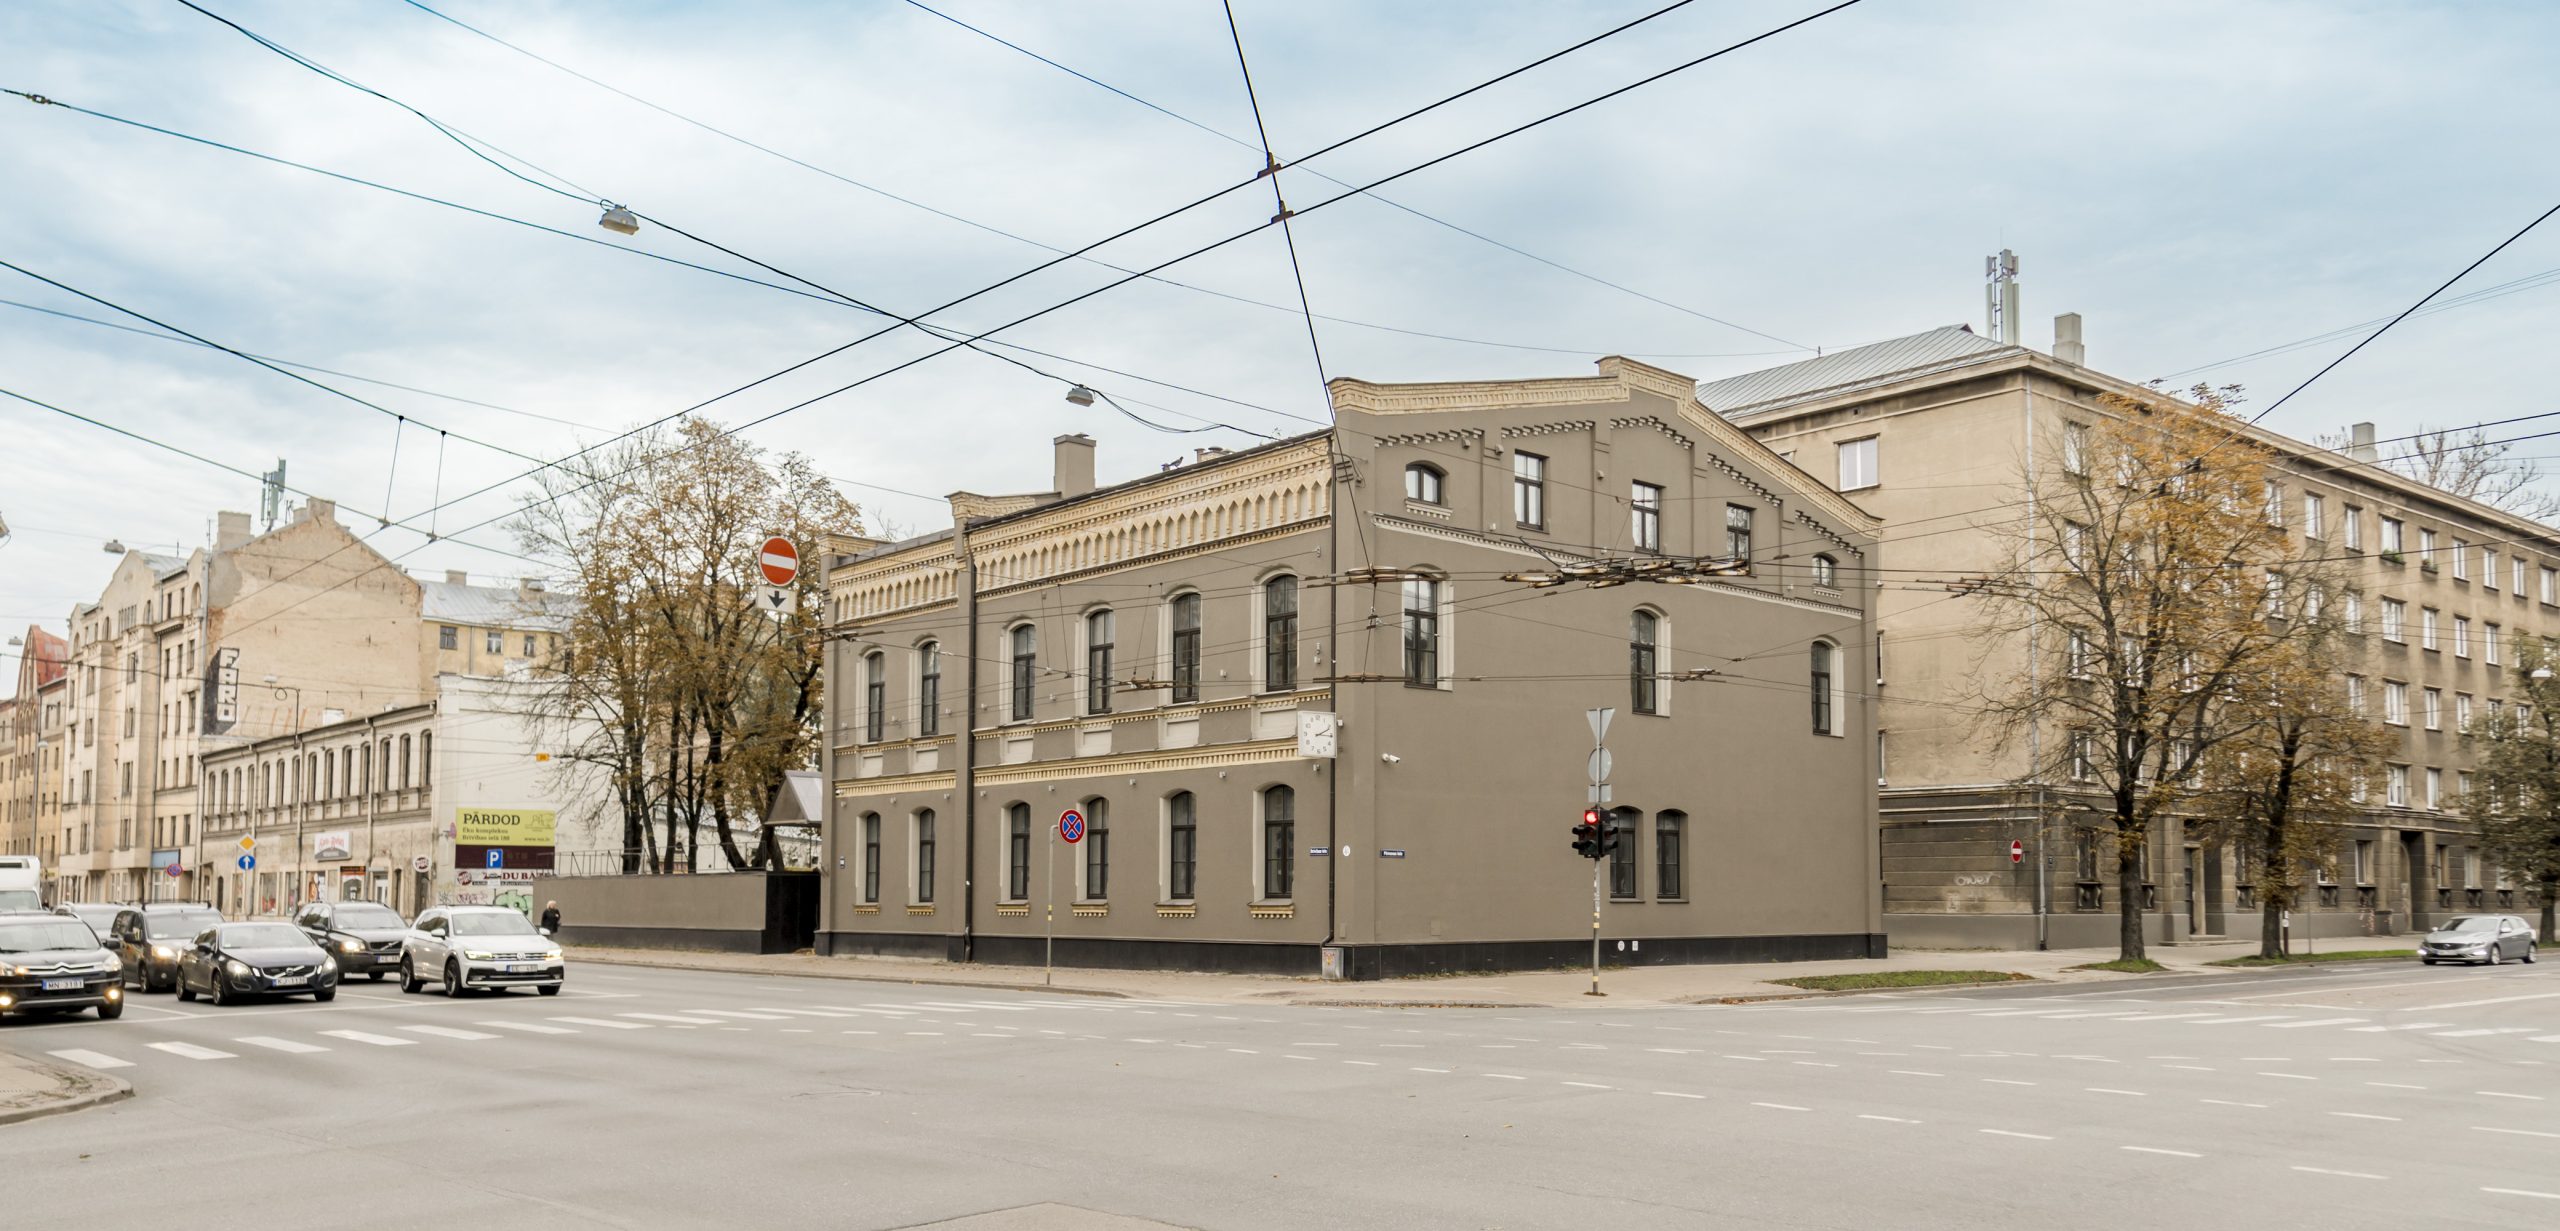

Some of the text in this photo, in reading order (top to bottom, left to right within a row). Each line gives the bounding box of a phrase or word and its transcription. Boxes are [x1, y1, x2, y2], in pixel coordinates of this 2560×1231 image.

[217, 648, 239, 722] FARO
[463, 811, 521, 825] PĀRDOD
[490, 851, 499, 867] P
